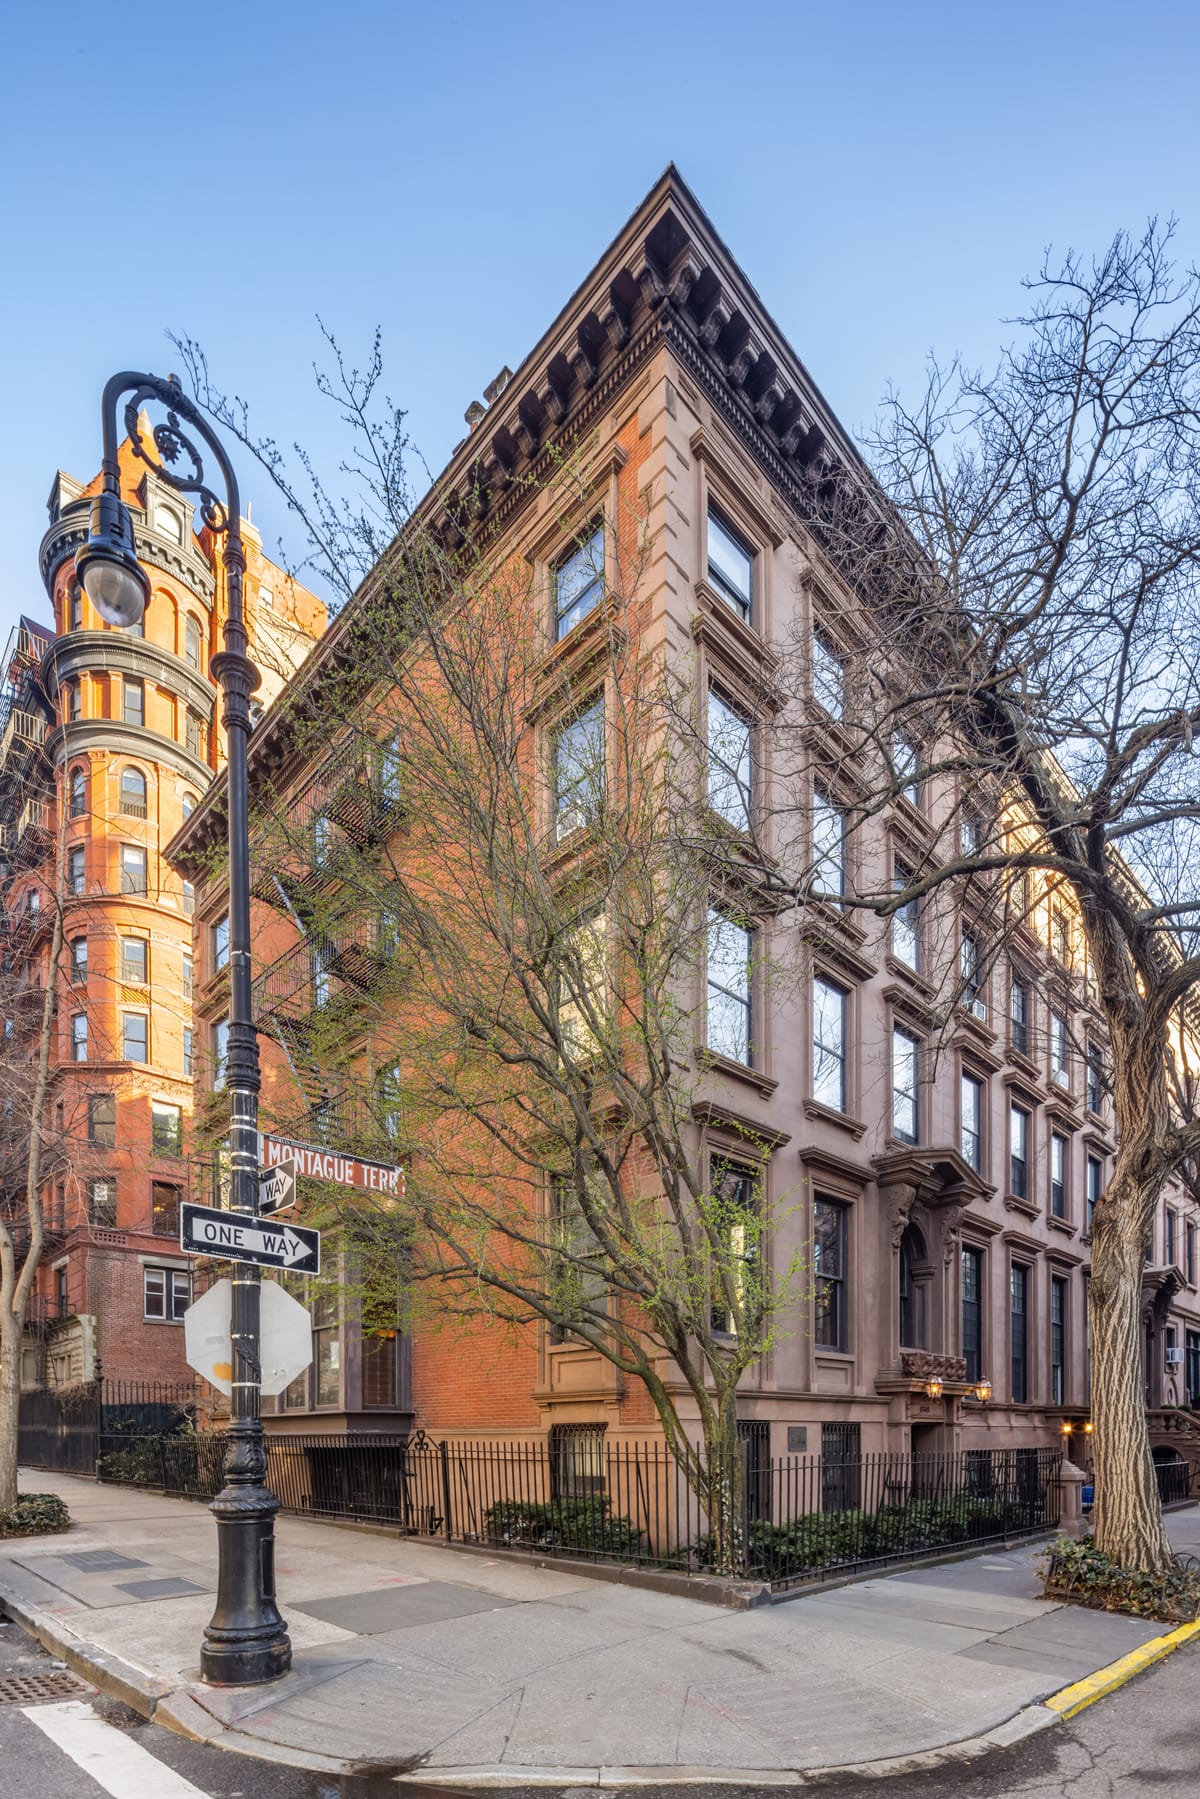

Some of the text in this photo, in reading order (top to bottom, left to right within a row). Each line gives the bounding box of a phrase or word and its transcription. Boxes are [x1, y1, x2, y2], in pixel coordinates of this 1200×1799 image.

[268, 1141, 354, 1185] MONTAGUE
[265, 1175, 287, 1201] WAY
[204, 1223, 245, 1247] ONE
[262, 1234, 301, 1257] WAY
